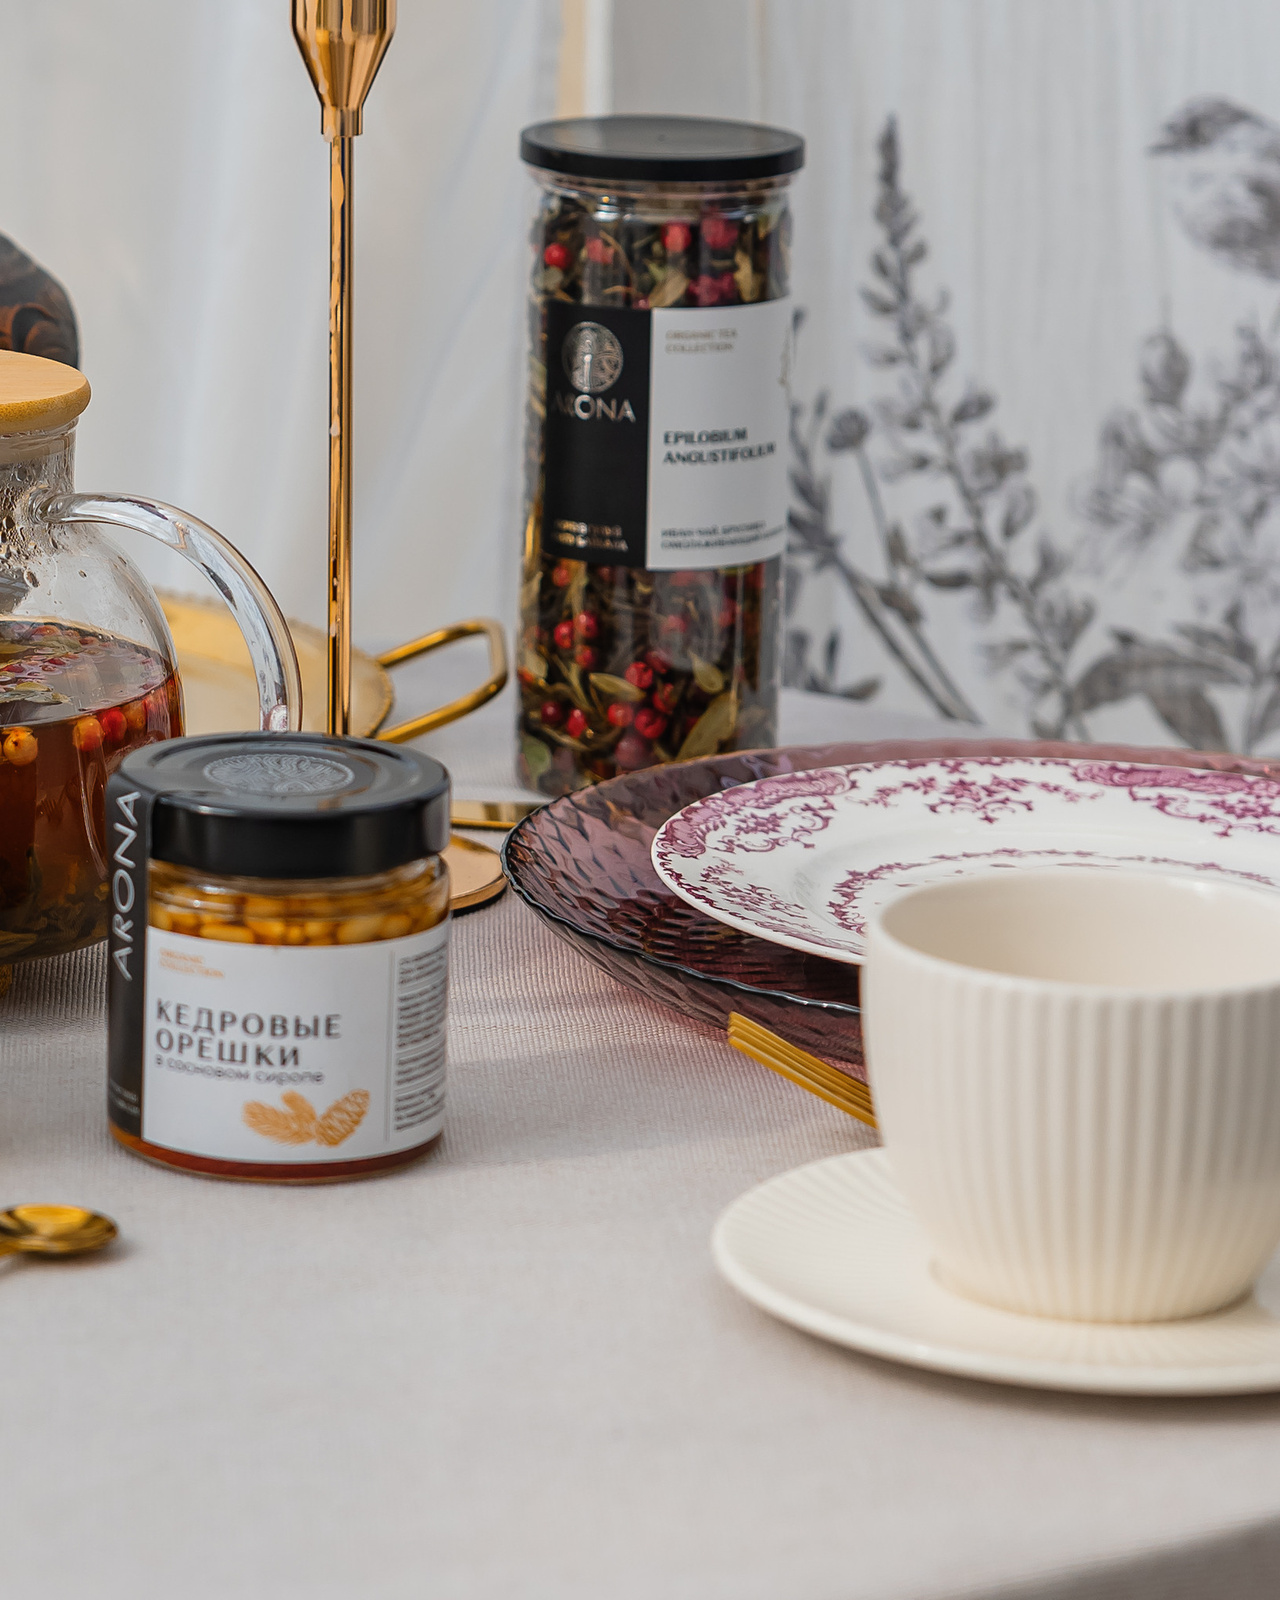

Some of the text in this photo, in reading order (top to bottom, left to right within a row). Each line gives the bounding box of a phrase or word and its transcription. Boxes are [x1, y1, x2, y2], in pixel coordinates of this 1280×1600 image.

[663, 427, 748, 446] EPILOBIUM
[112, 791, 142, 982] ARONA
[156, 998, 342, 1041] КЕДРОВЫЕ
[155, 1027, 301, 1068] ОРЕШКИ
[168, 1057, 250, 1080] сосновом
[255, 1069, 325, 1086] сиропе
